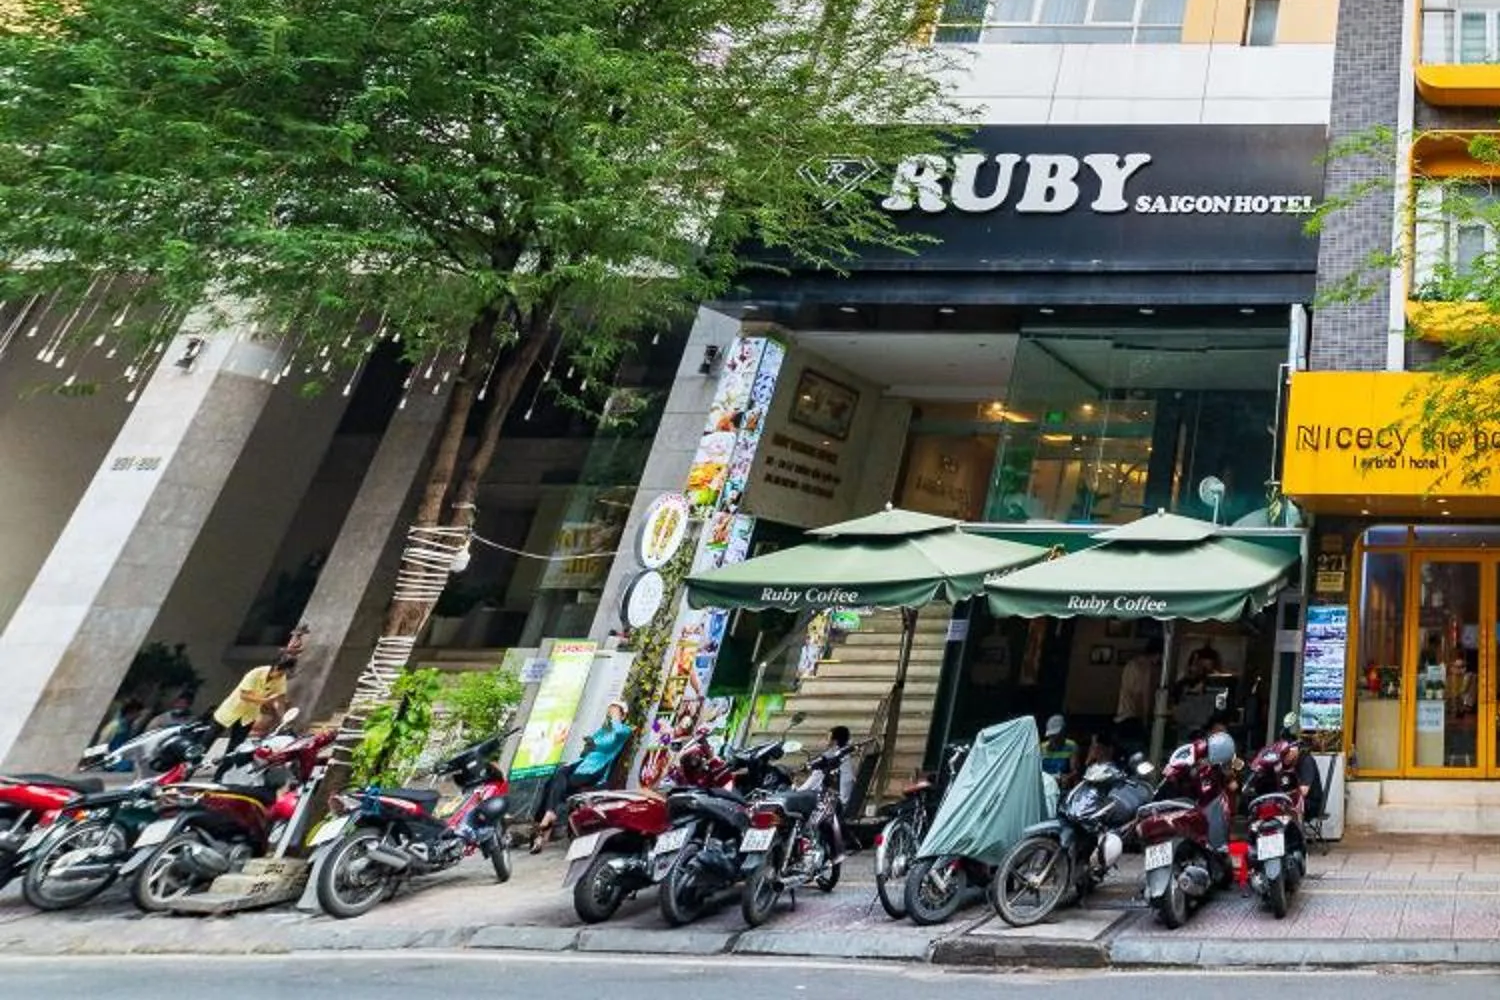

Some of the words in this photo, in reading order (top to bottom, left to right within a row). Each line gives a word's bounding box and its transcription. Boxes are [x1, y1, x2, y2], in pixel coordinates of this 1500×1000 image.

[882, 152, 1152, 214] RUBY
[1135, 194, 1231, 214] SAIGON
[1233, 194, 1318, 214] HOTEL
[1296, 424, 1410, 457] Nicecy
[760, 587, 802, 603] Ruby
[805, 587, 858, 603] Coffee
[1067, 595, 1109, 613] Ruby
[1112, 597, 1167, 612] Coffee
